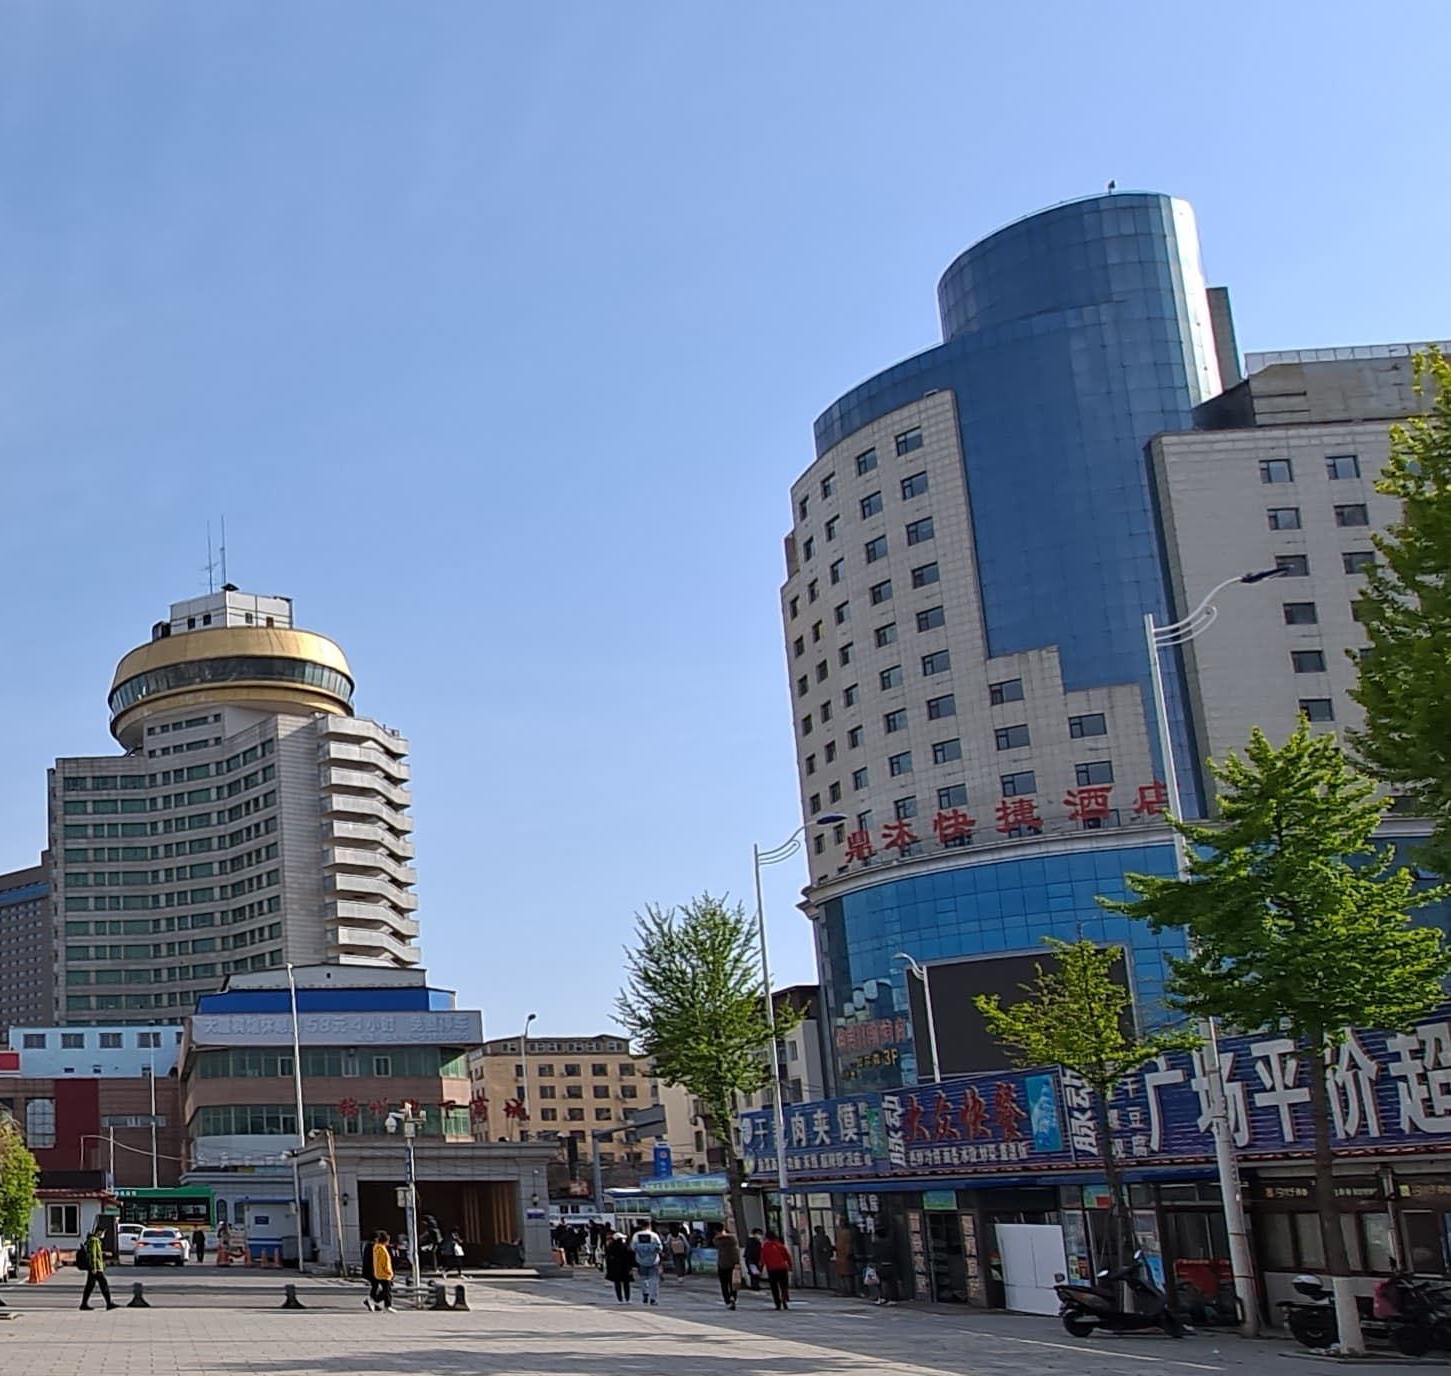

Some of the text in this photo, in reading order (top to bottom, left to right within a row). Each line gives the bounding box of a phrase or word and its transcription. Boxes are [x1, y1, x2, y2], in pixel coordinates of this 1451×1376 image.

[844, 780, 1169, 863] 鼎沐快捷酒店
[904, 1080, 1028, 1143] 大众快餐
